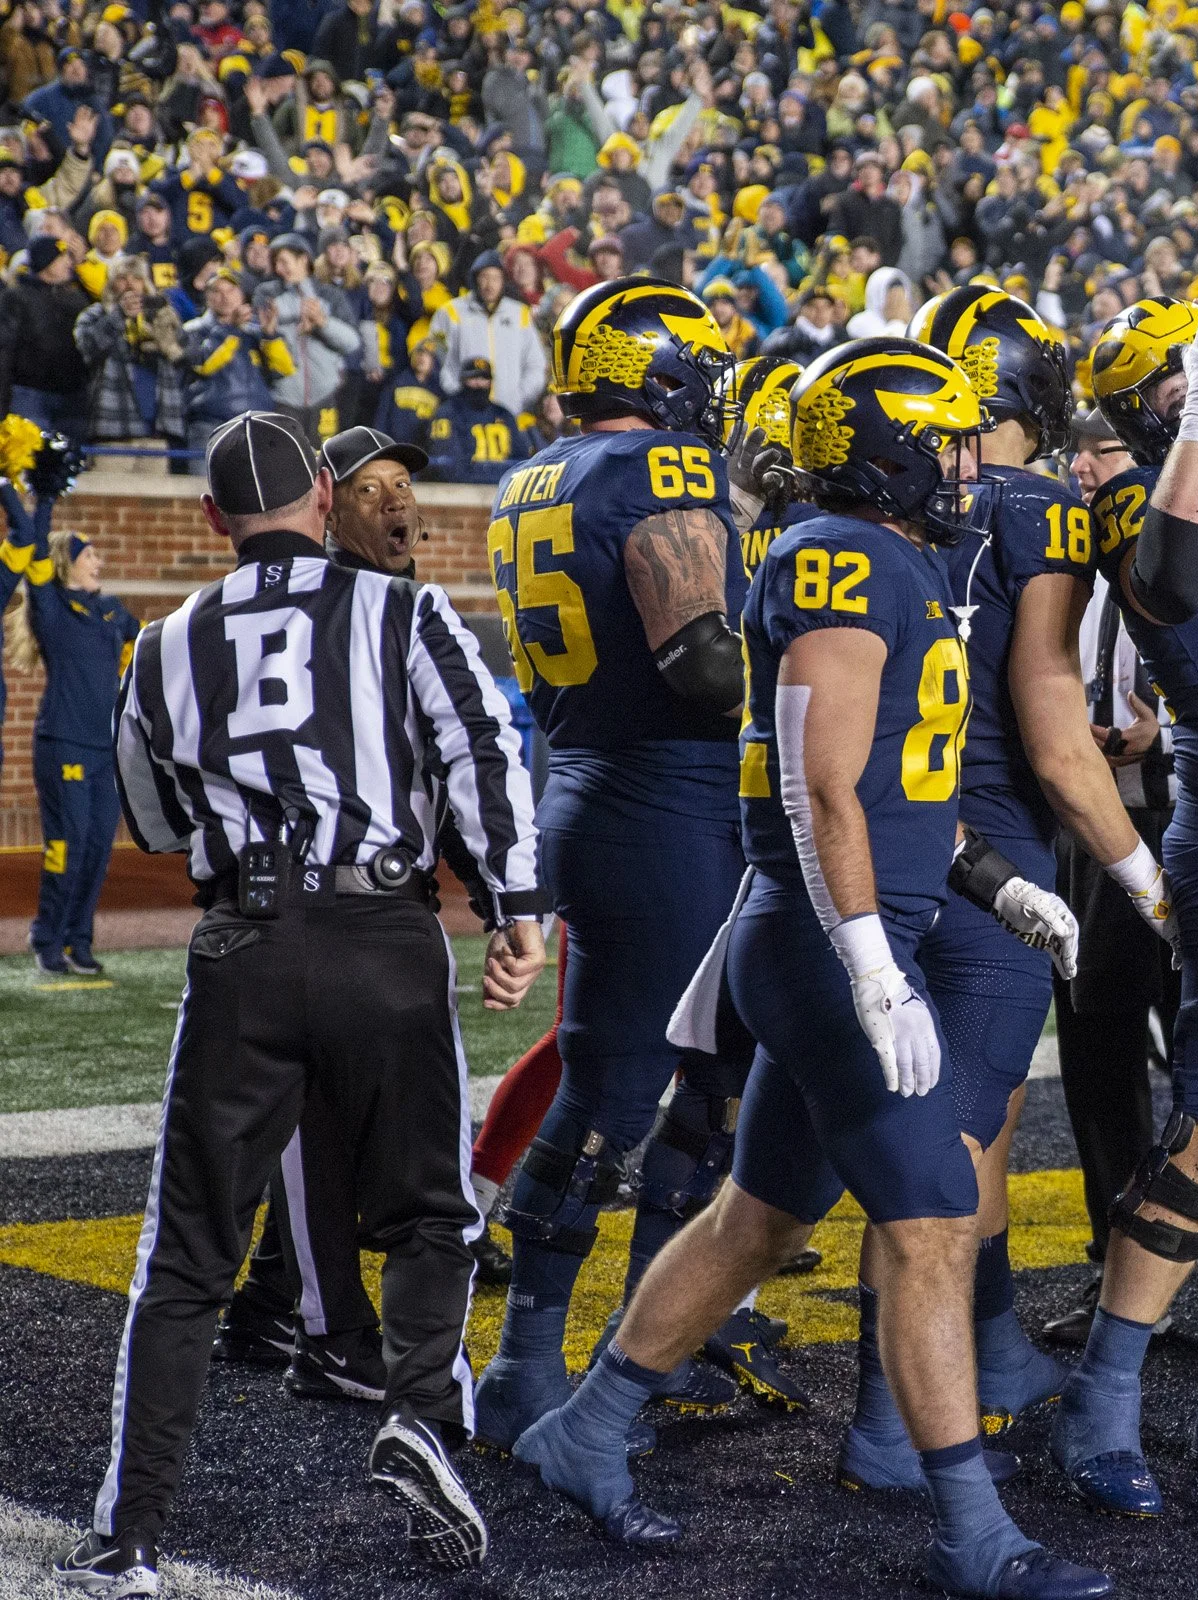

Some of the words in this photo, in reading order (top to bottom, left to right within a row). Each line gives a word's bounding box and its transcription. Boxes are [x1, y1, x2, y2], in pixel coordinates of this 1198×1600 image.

[471, 422, 511, 463] 10
[647, 446, 716, 499] 65
[1044, 503, 1091, 564] 18
[1093, 484, 1146, 554] 52
[487, 503, 599, 693] 65
[794, 548, 870, 614] 82
[223, 606, 314, 738] B
